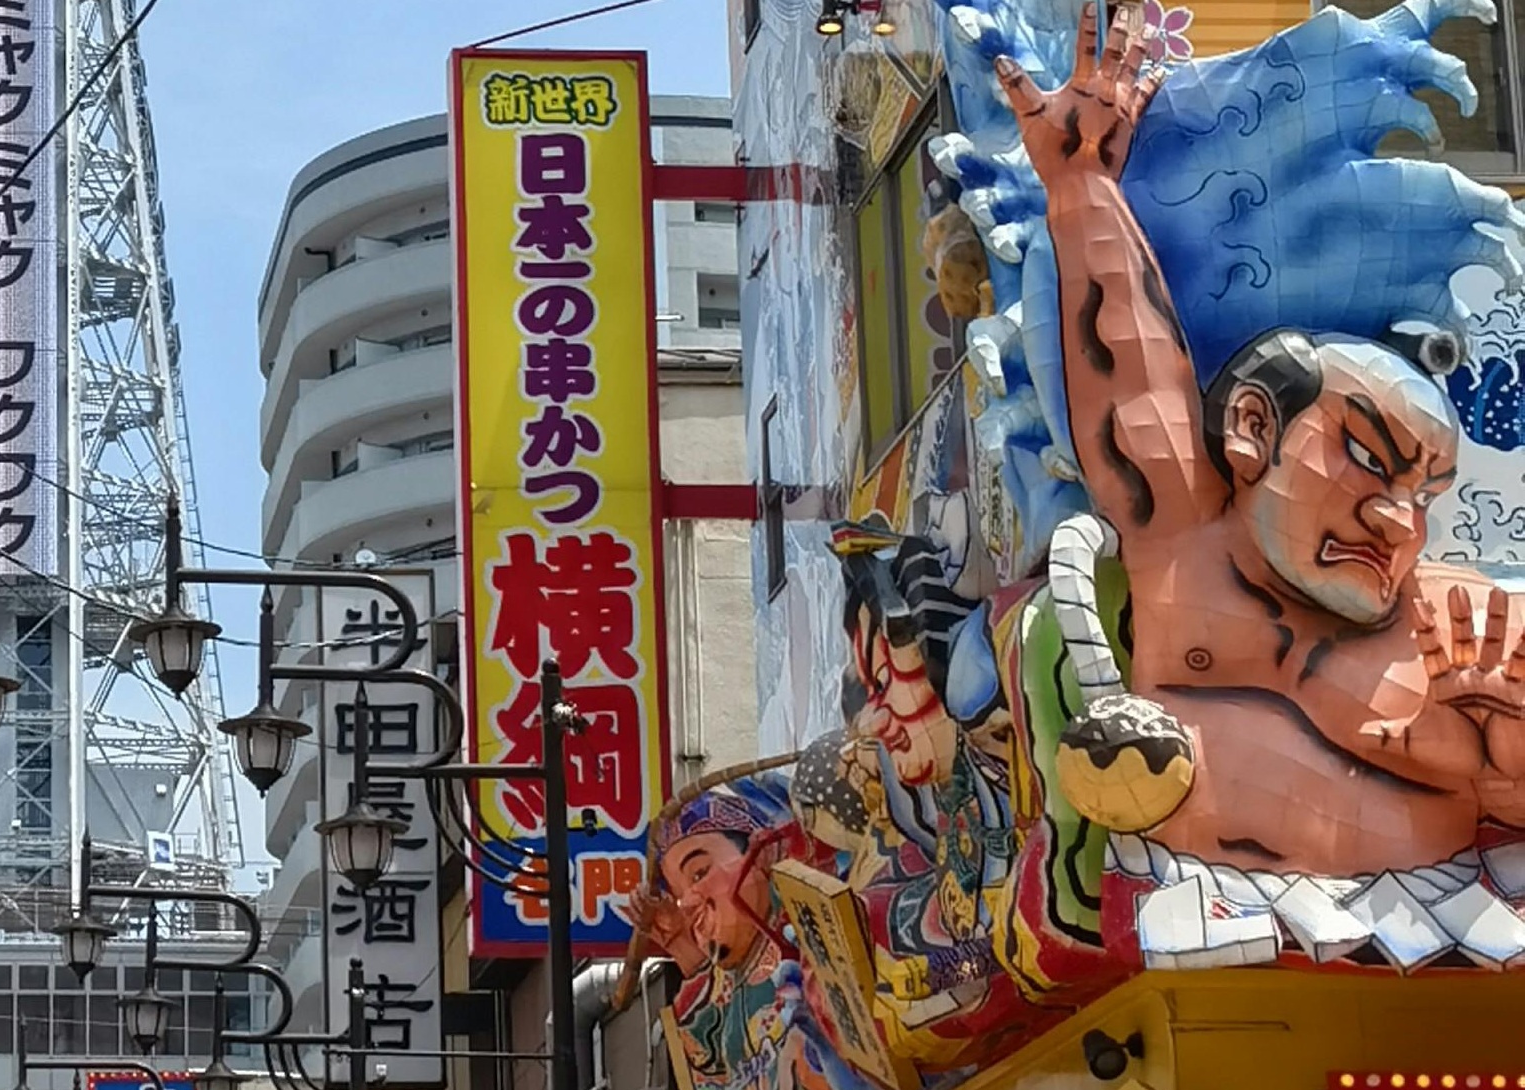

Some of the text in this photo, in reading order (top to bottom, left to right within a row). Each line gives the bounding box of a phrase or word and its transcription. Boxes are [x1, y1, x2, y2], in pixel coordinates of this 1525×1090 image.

[487, 76, 616, 127] 新世界
[514, 133, 600, 523] 日本一の串かつ
[492, 534, 643, 832] 横綱
